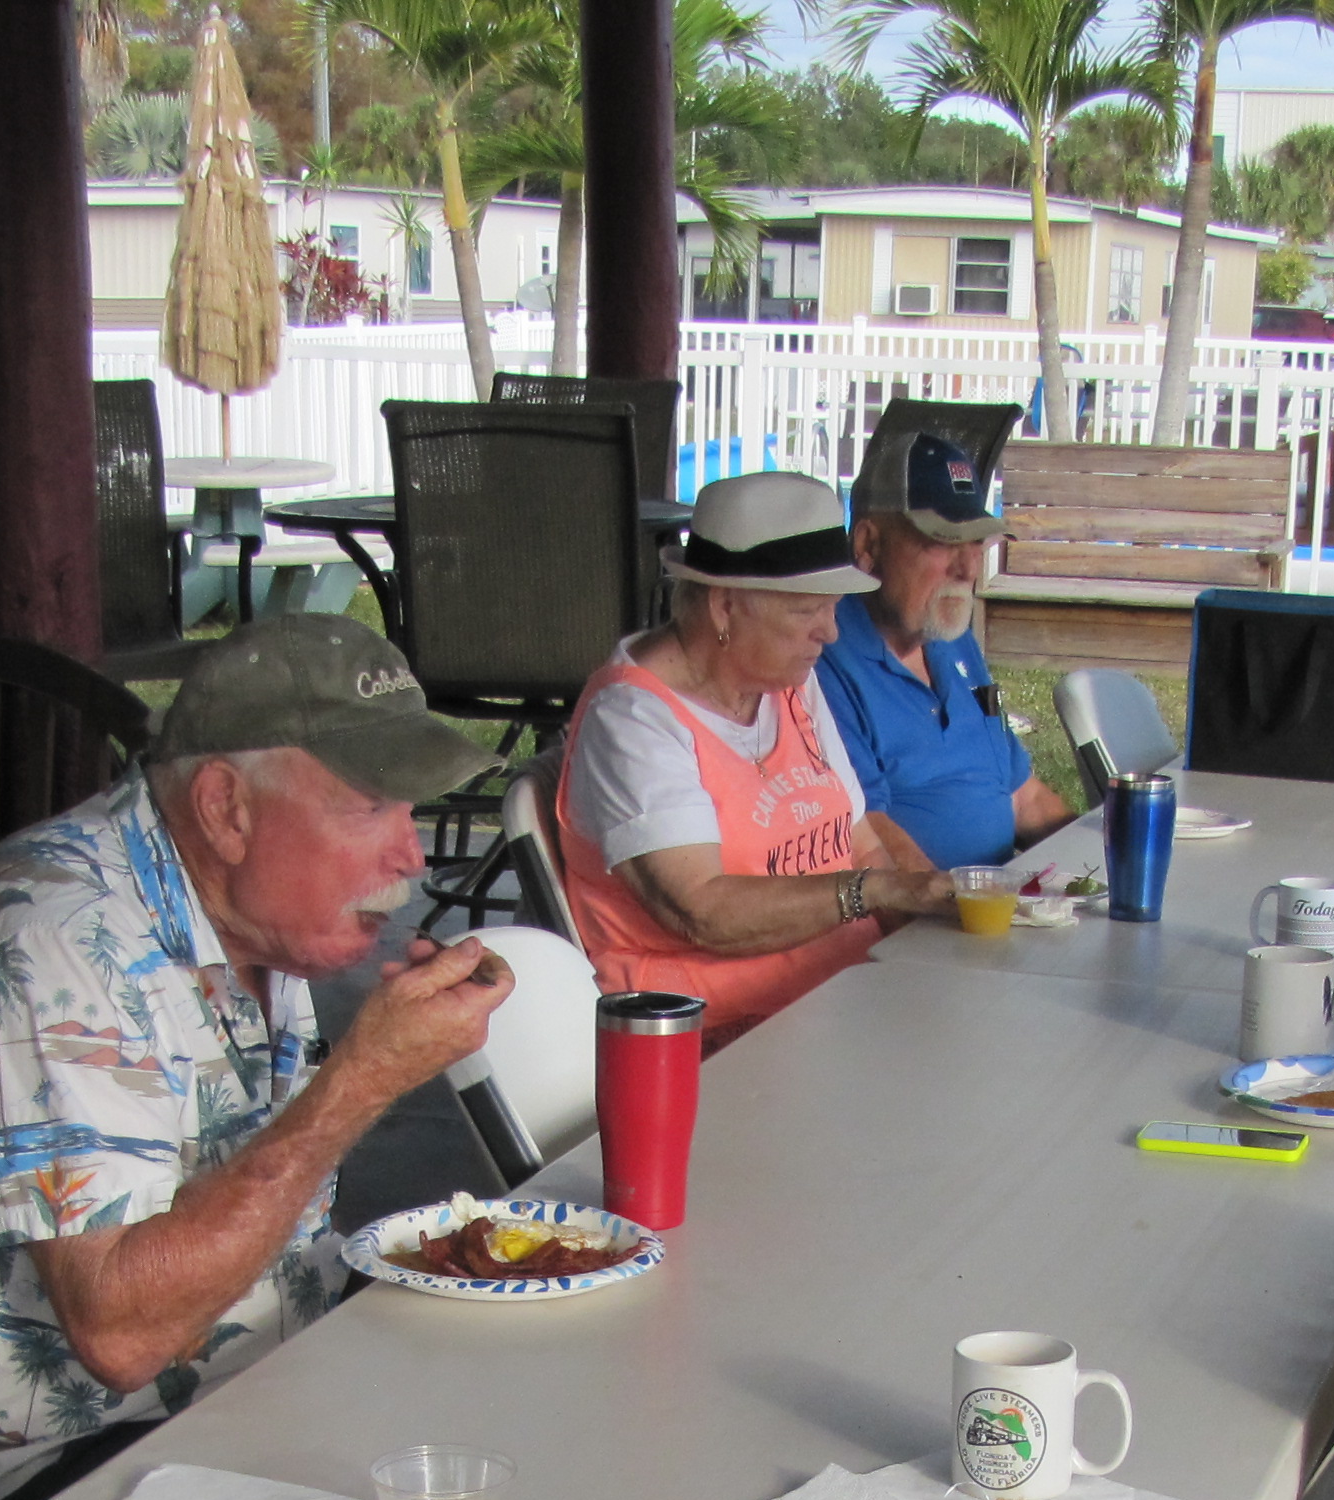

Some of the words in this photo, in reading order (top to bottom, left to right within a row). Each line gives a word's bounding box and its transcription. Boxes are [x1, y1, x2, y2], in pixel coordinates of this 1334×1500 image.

[791, 801, 823, 825] The
[974, 1392, 996, 1403] LIVE
[1000, 1393, 1042, 1438] STEAMERS
[997, 1456, 1038, 1488] FLORIDA
